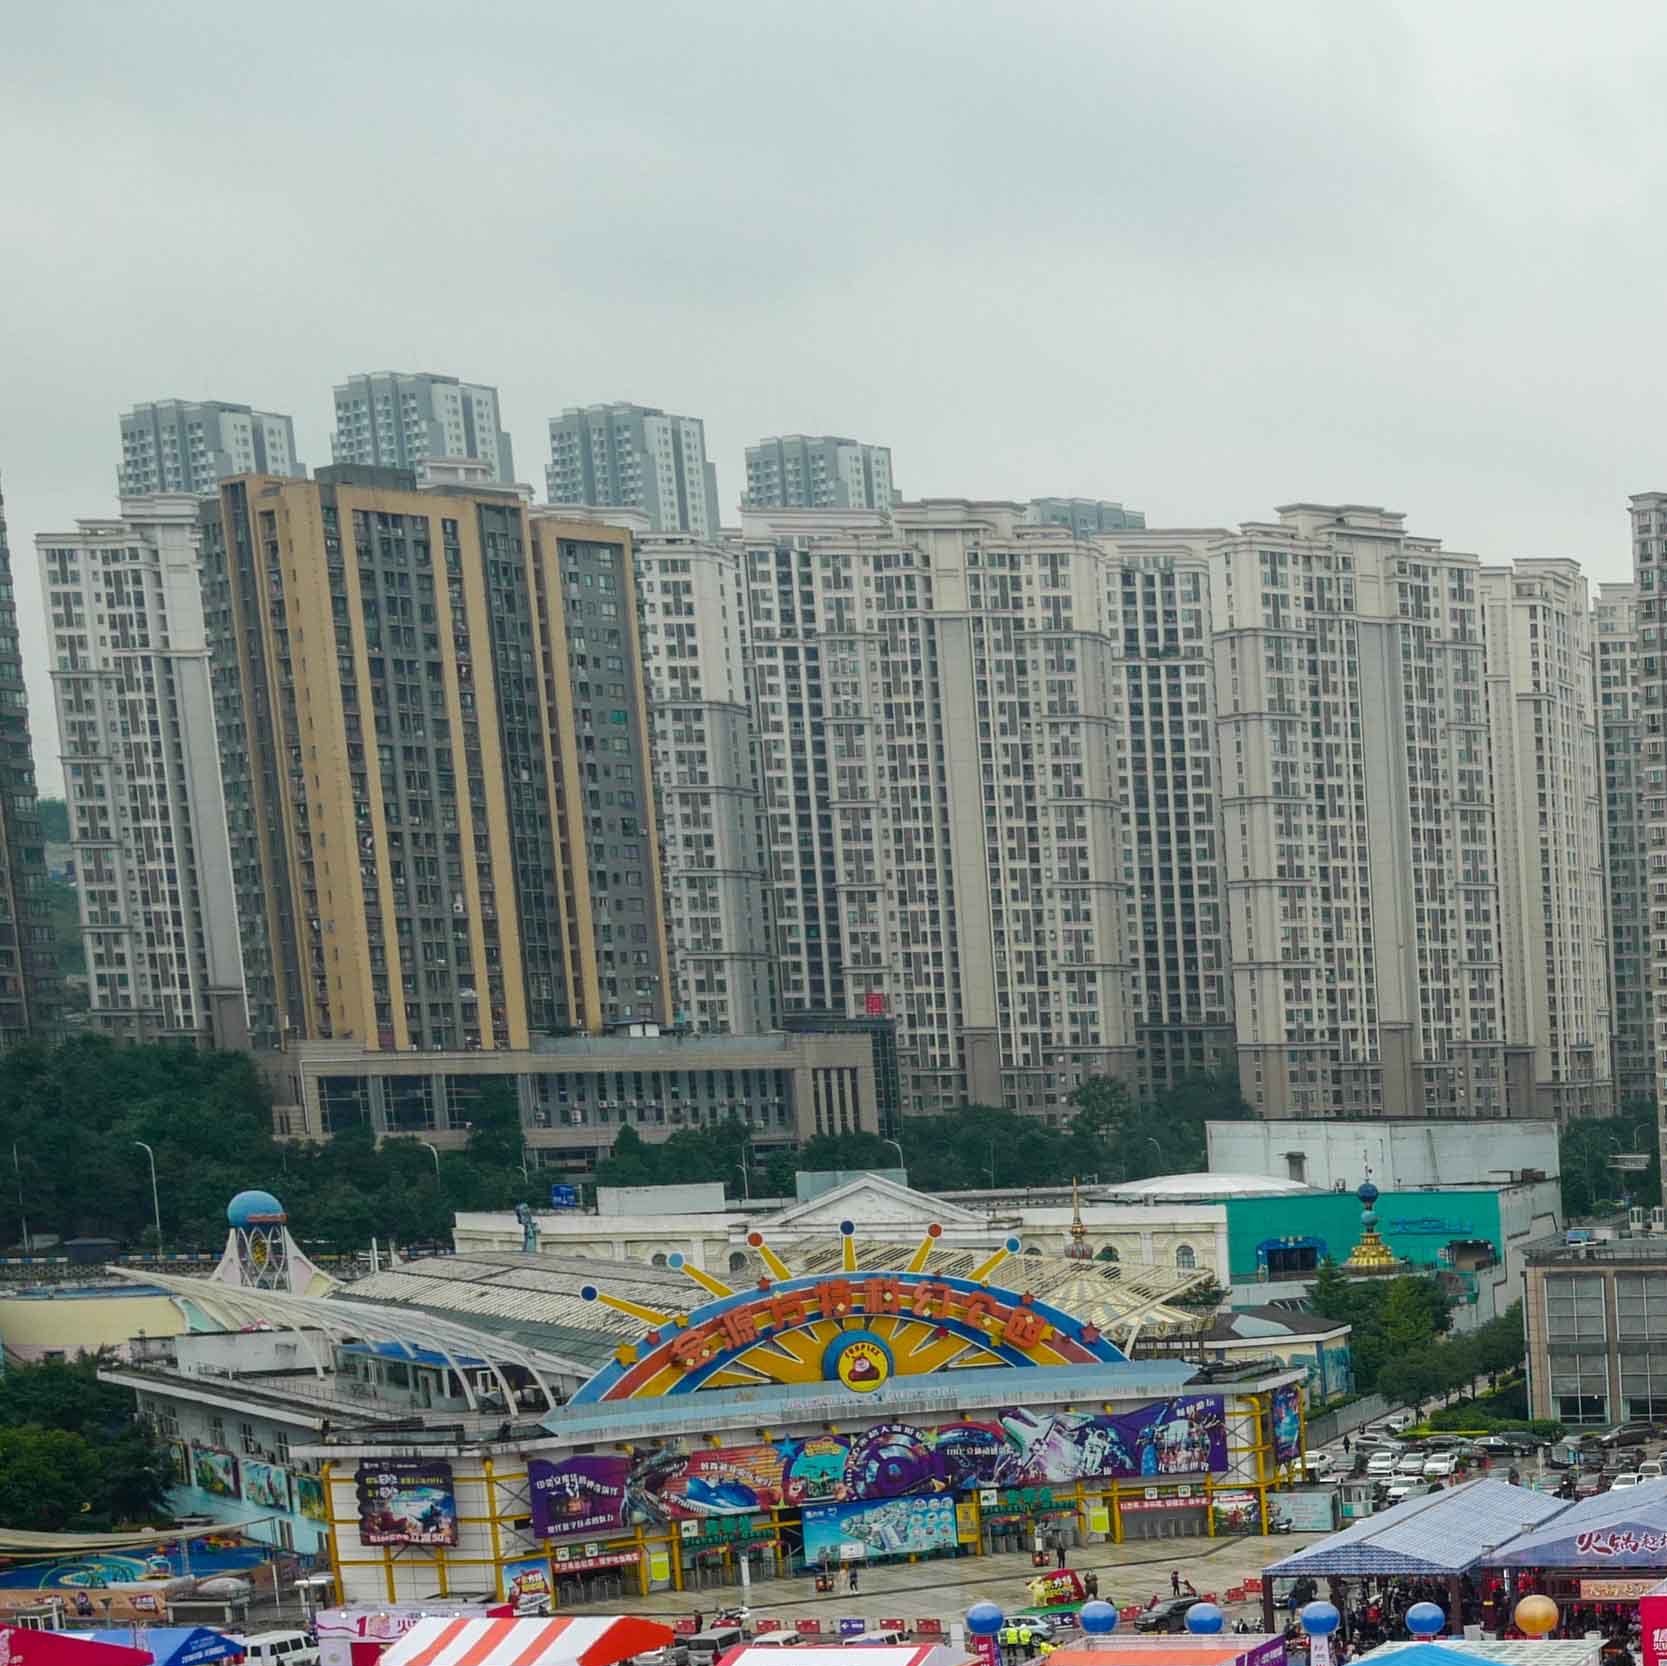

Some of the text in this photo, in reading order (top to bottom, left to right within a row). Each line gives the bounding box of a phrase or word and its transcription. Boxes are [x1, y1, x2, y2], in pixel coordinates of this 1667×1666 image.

[670, 1278, 1047, 1373] 金源方特科幻公园
